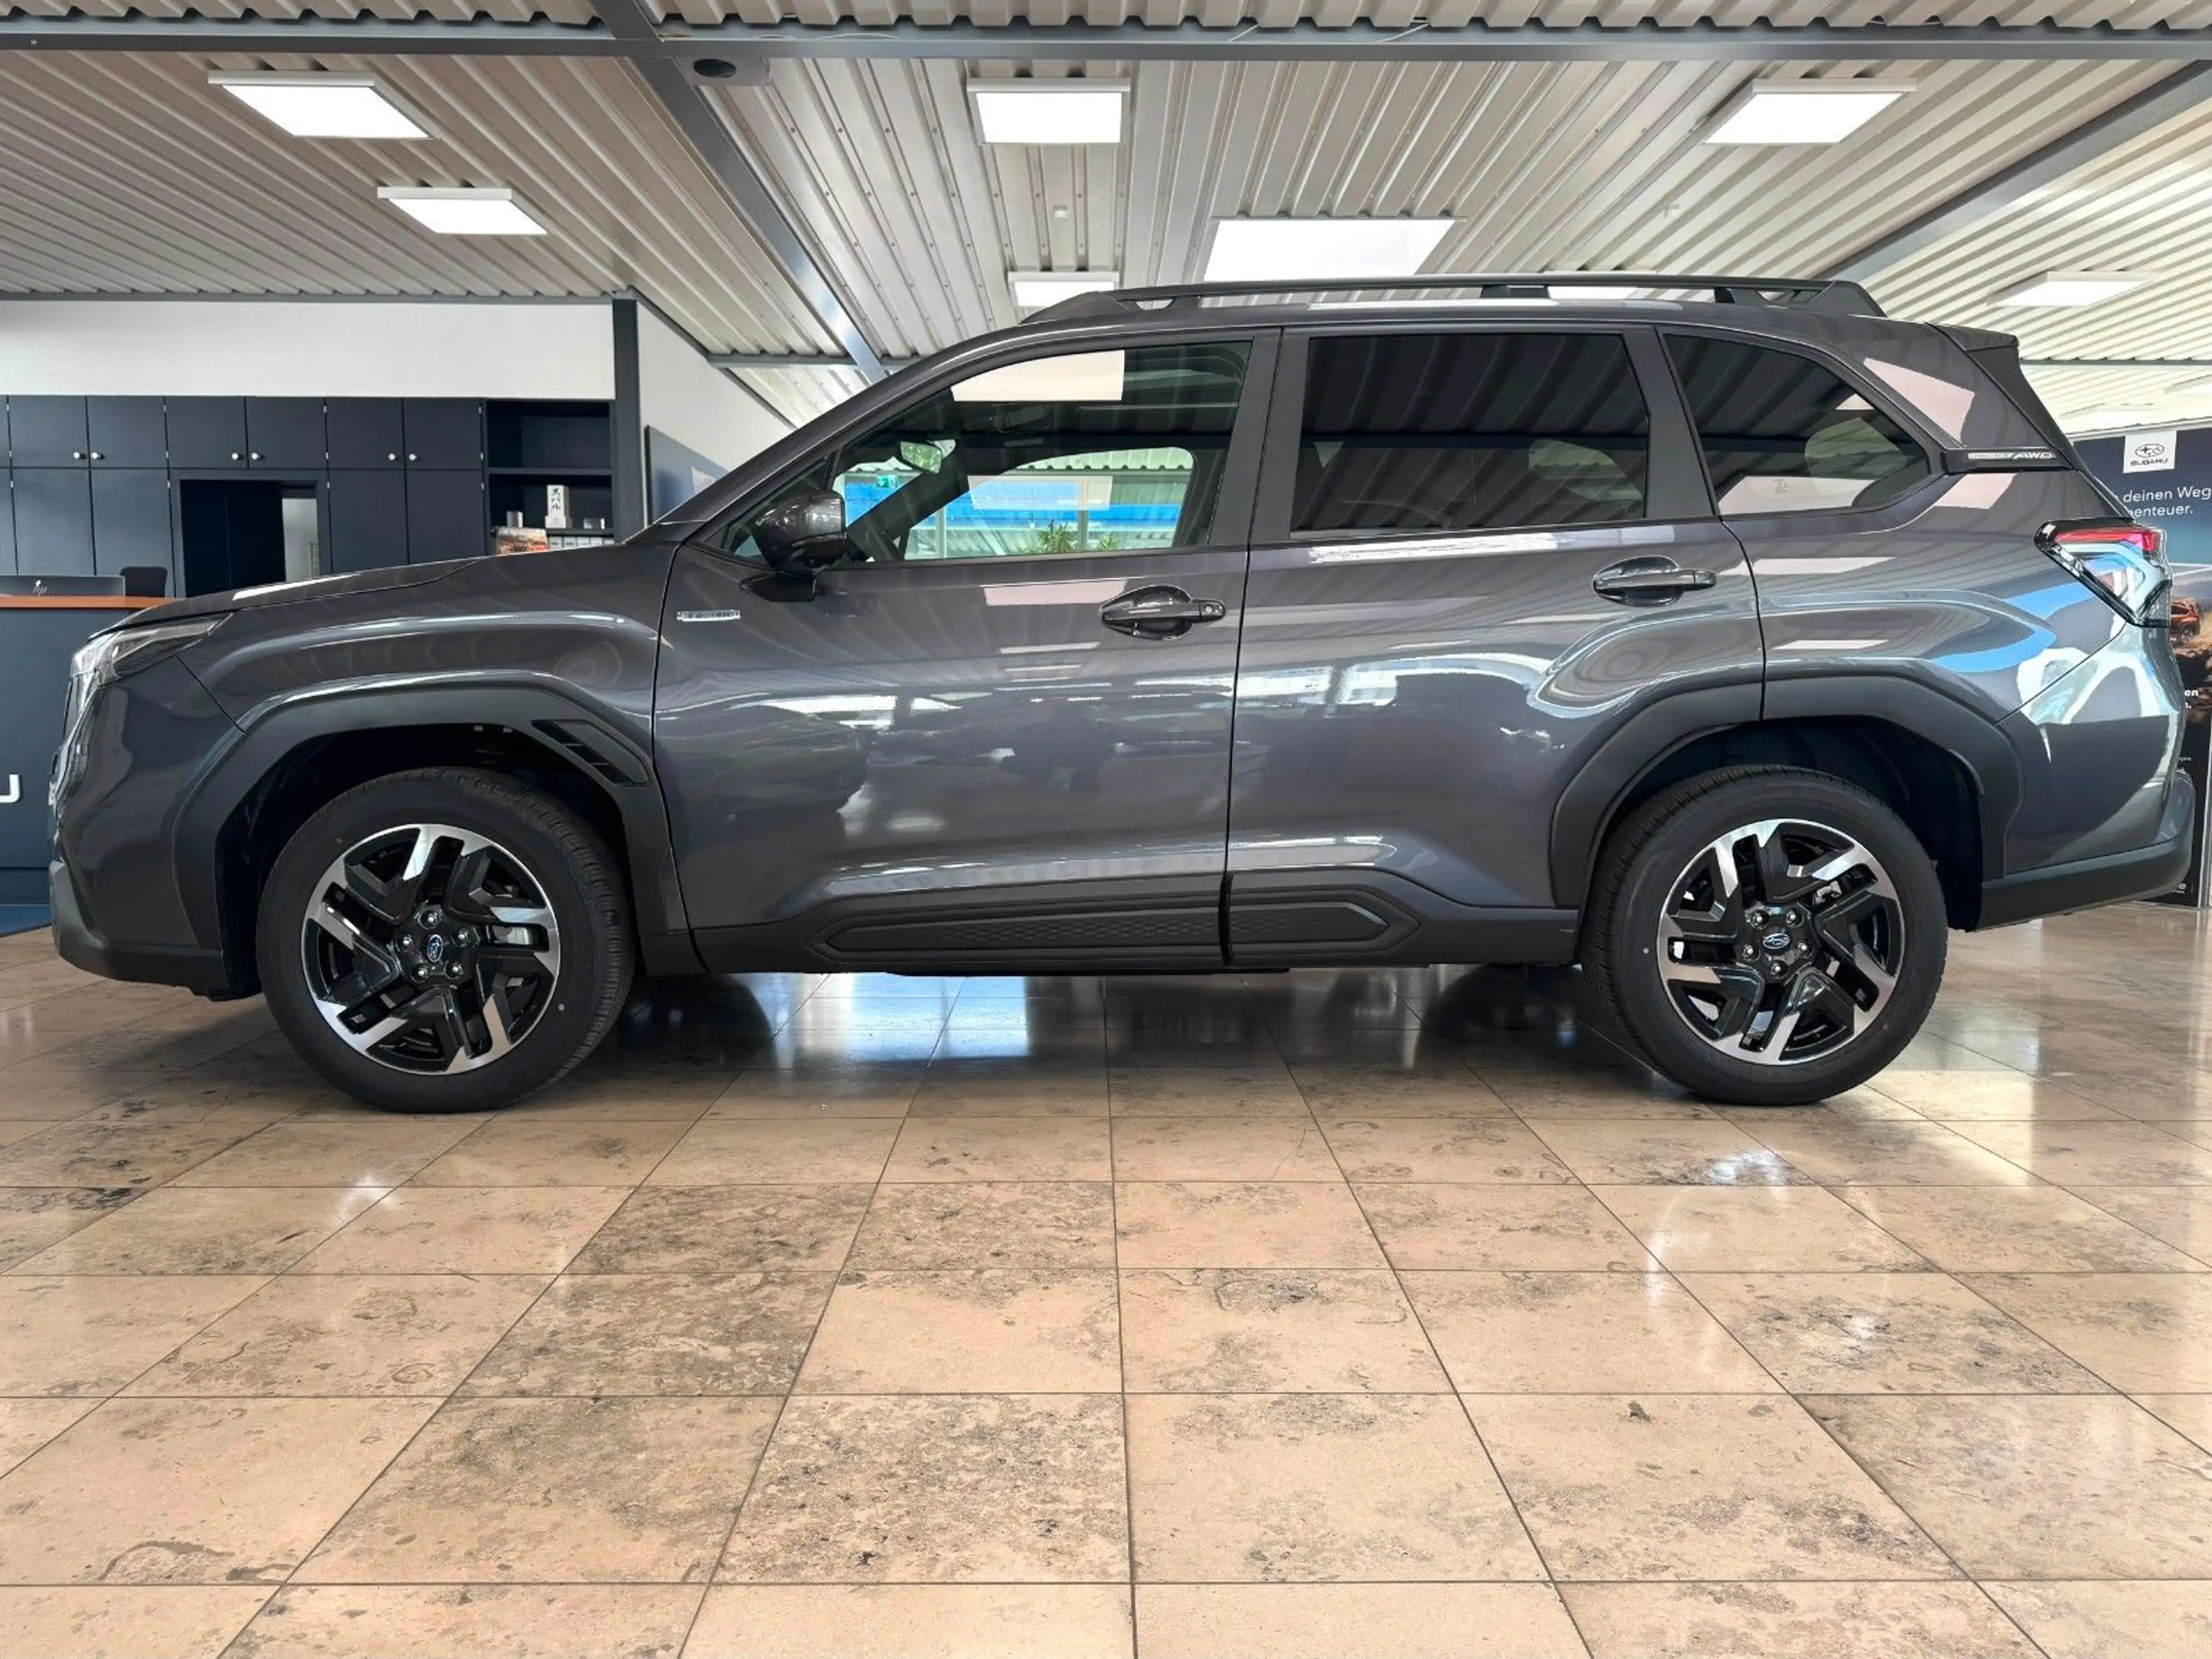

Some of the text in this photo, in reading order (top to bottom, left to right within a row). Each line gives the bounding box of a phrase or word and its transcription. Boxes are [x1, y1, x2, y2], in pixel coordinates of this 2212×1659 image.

[2013, 452, 2054, 460] AWD
[2123, 486, 2211, 502] deinen Weg
